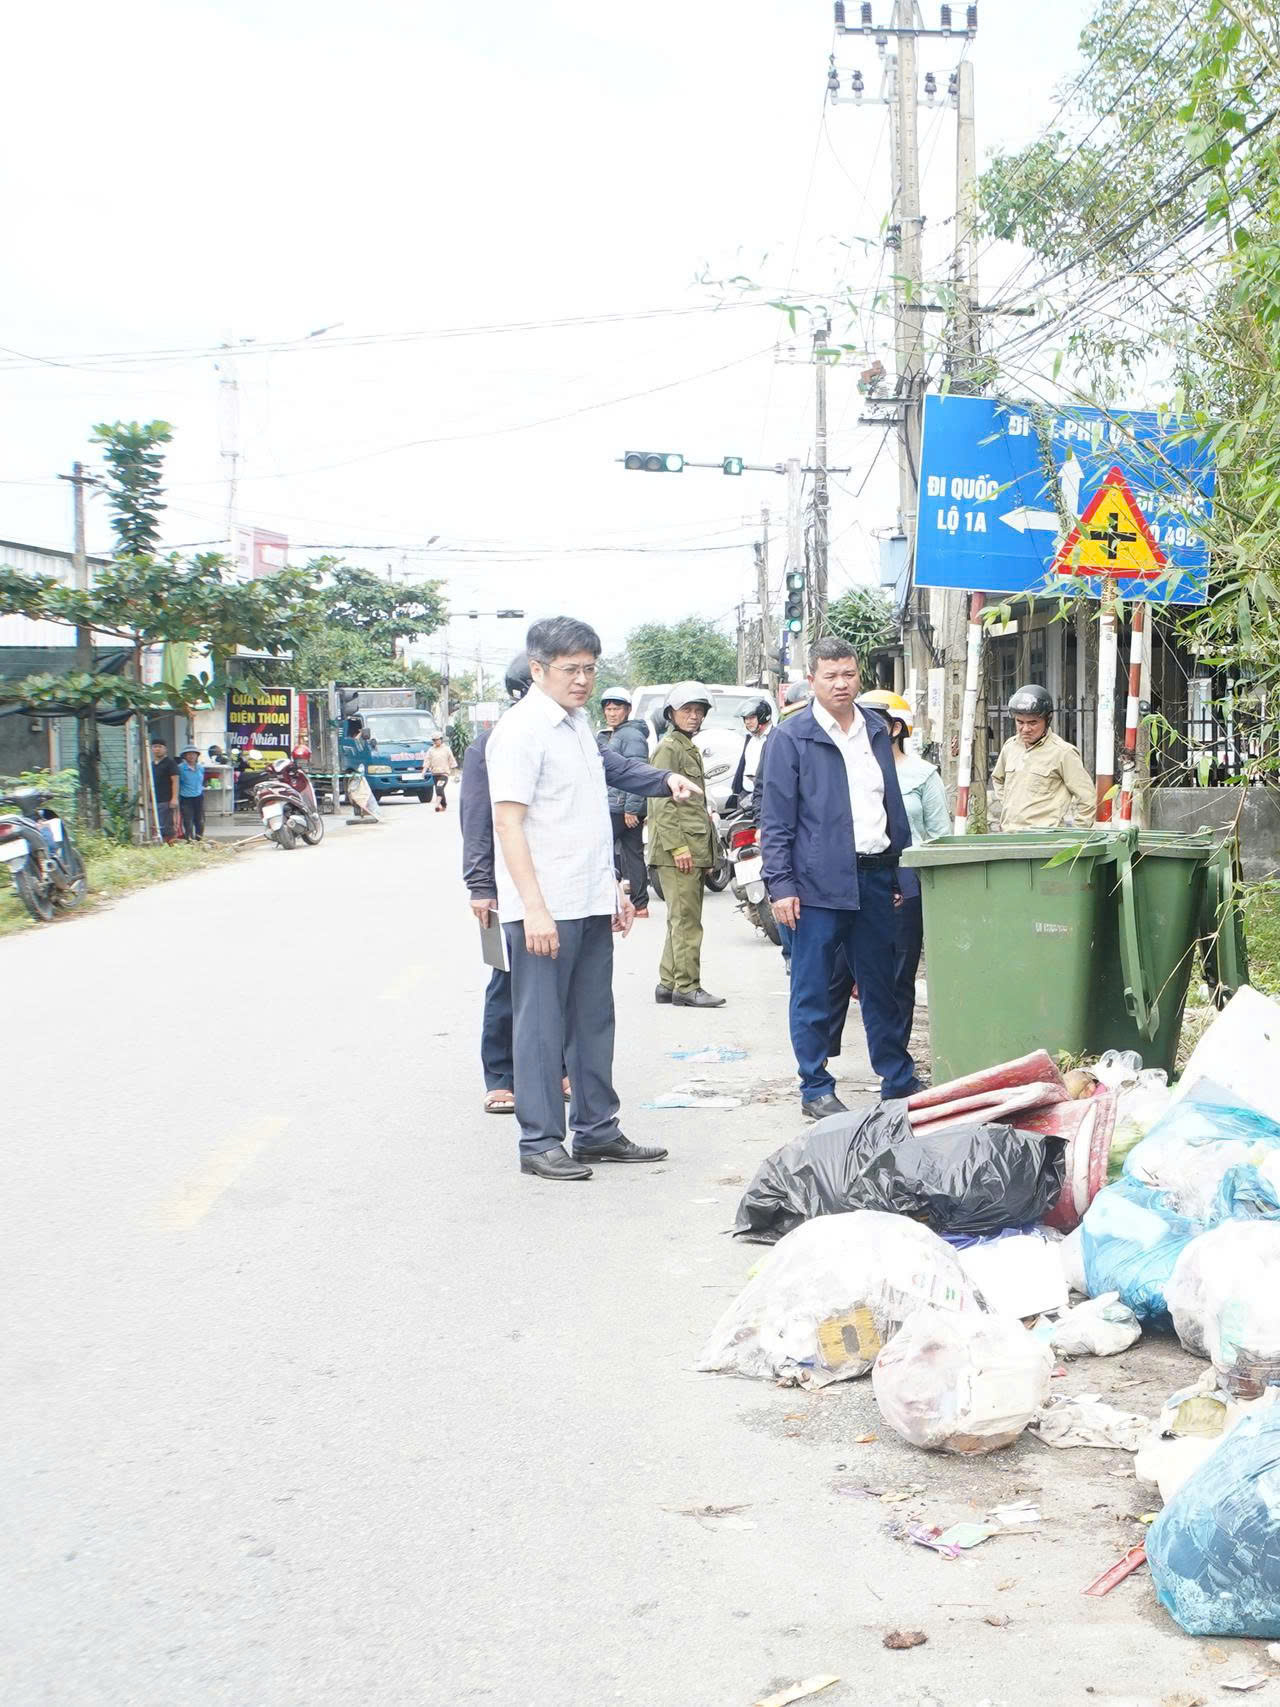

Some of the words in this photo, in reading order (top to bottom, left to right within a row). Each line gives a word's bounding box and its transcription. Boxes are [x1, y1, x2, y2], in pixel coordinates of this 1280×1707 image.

[1008, 415, 1030, 437] ĐI
[927, 475, 947, 496] ĐI
[950, 474, 999, 501] QUỐC
[937, 505, 960, 535] LỘ
[964, 511, 988, 533] 1A
[230, 710, 256, 726] ĐIỆN
[258, 712, 290, 727] THOẠI
